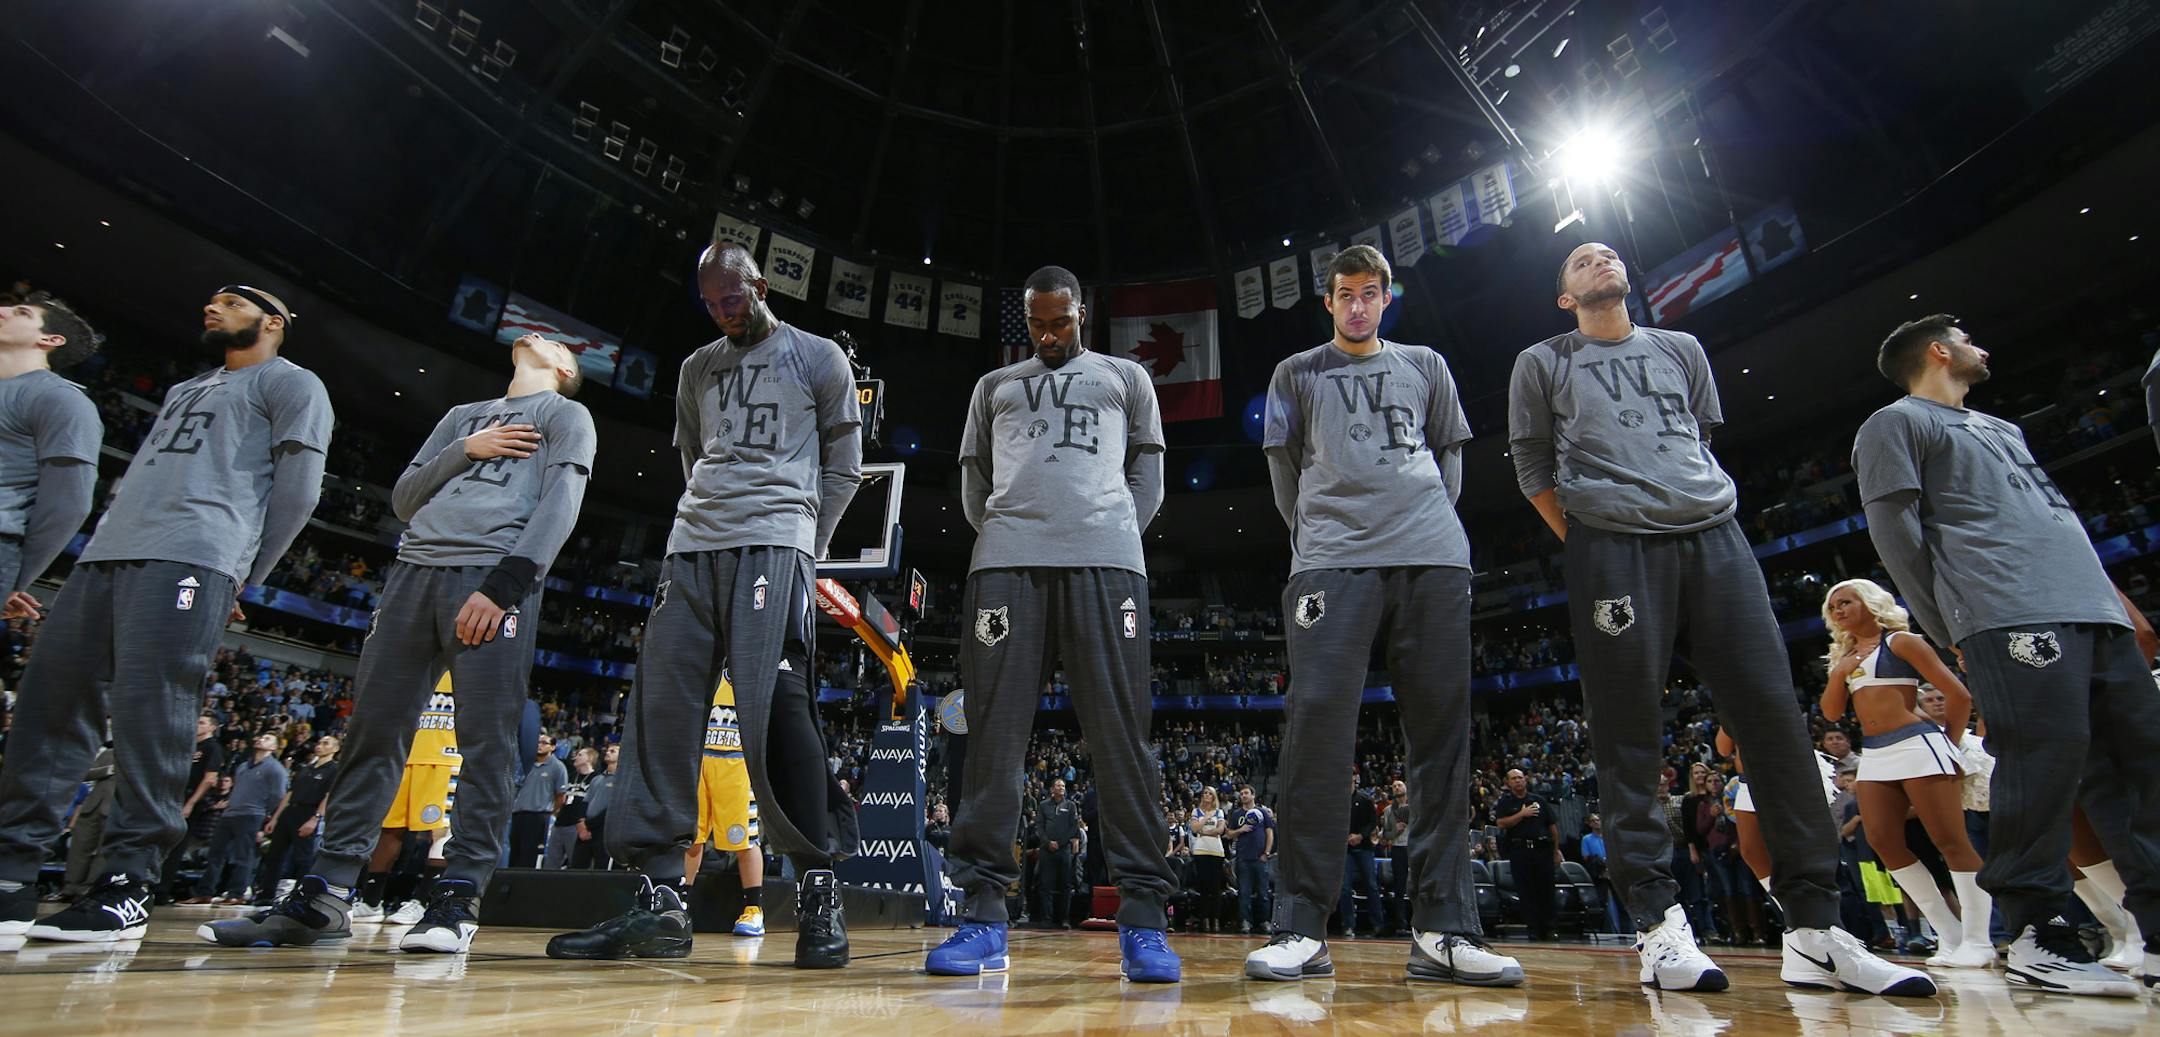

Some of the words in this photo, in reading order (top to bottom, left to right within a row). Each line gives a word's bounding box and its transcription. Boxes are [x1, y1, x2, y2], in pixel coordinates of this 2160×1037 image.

[720, 226, 753, 244] BECK
[773, 257, 804, 281] 33
[835, 280, 867, 303] 432
[895, 293, 922, 311] 44
[953, 304, 967, 321] 2
[711, 364, 779, 451] WE
[1014, 372, 1099, 454] WE
[1326, 371, 1416, 455] WE
[419, 715, 455, 730] GGETS
[880, 724, 910, 733] SPALDING
[705, 730, 741, 746] GGETS
[917, 705, 928, 784] xfinity
[870, 748, 915, 763] AVAYA
[861, 792, 914, 809] AVAYA
